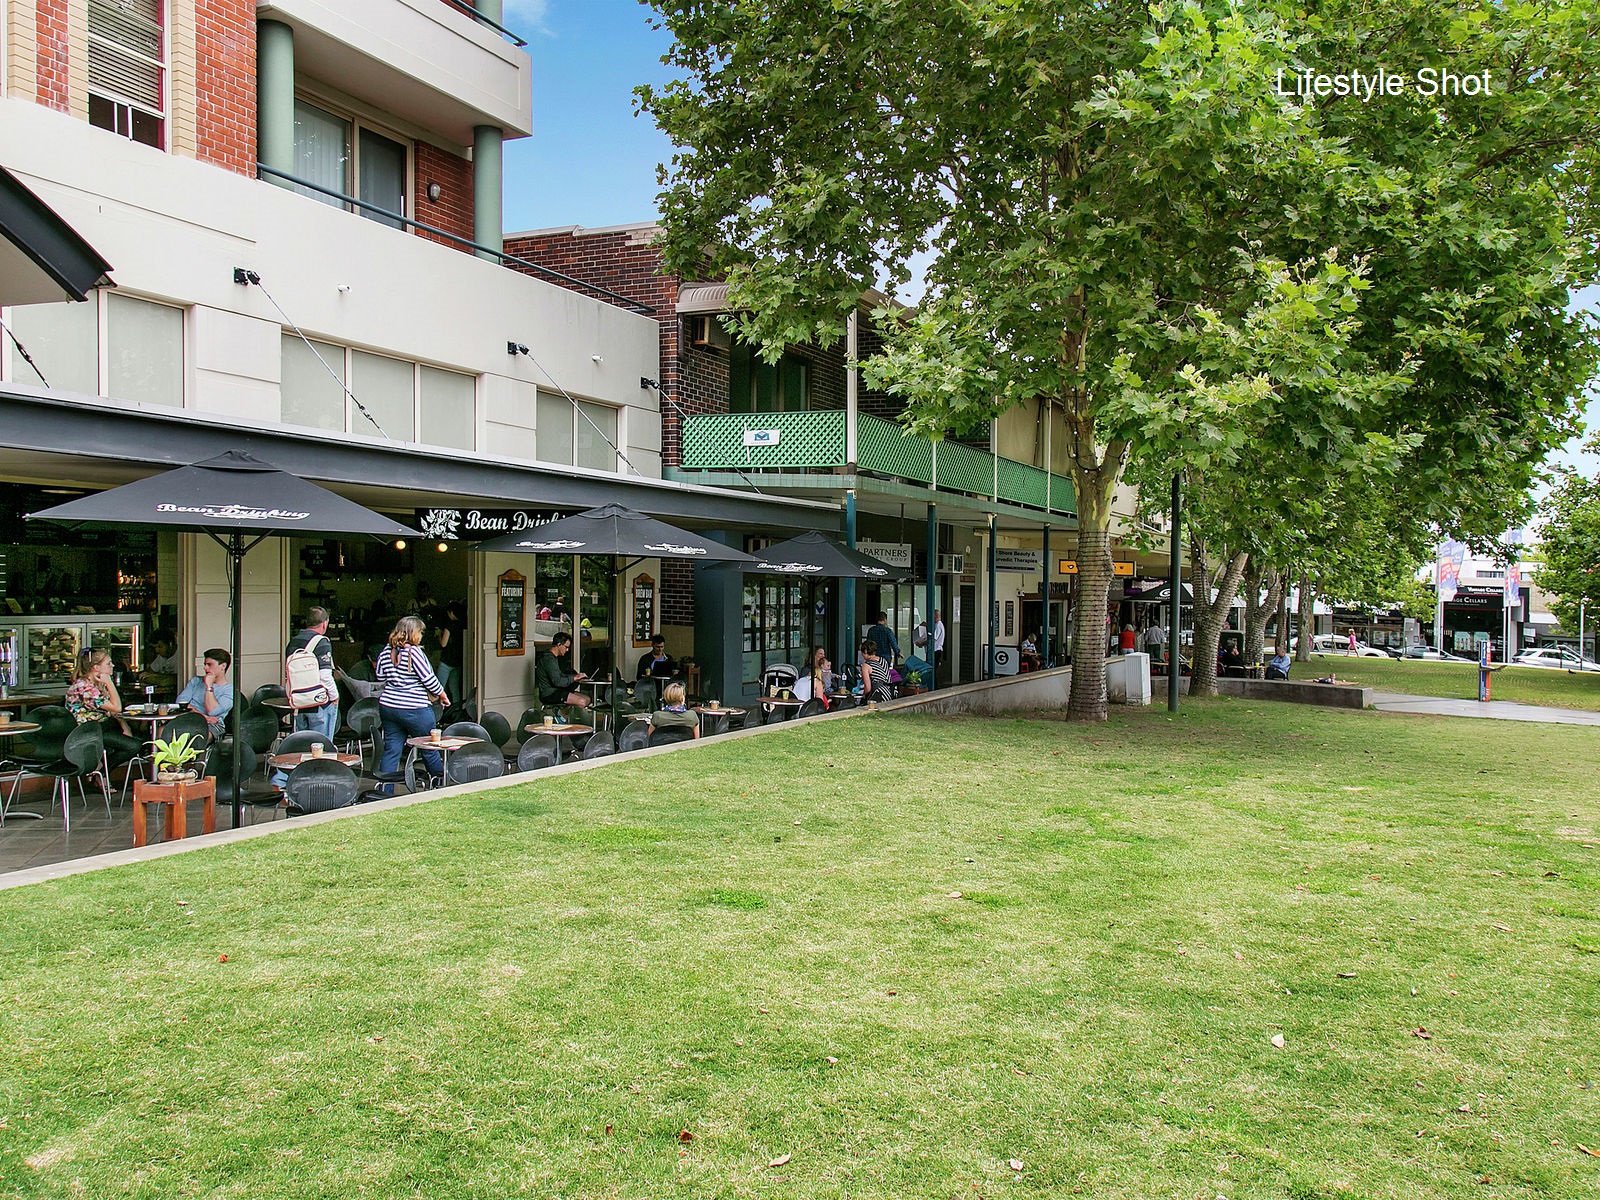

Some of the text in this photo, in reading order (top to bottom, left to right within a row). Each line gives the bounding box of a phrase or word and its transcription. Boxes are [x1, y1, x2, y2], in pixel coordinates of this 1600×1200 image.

[156, 503, 310, 520] Bean Drinking
[465, 510, 509, 530] Bean
[863, 547, 908, 558] PARTNERS
[501, 587, 523, 597] FEATURING
